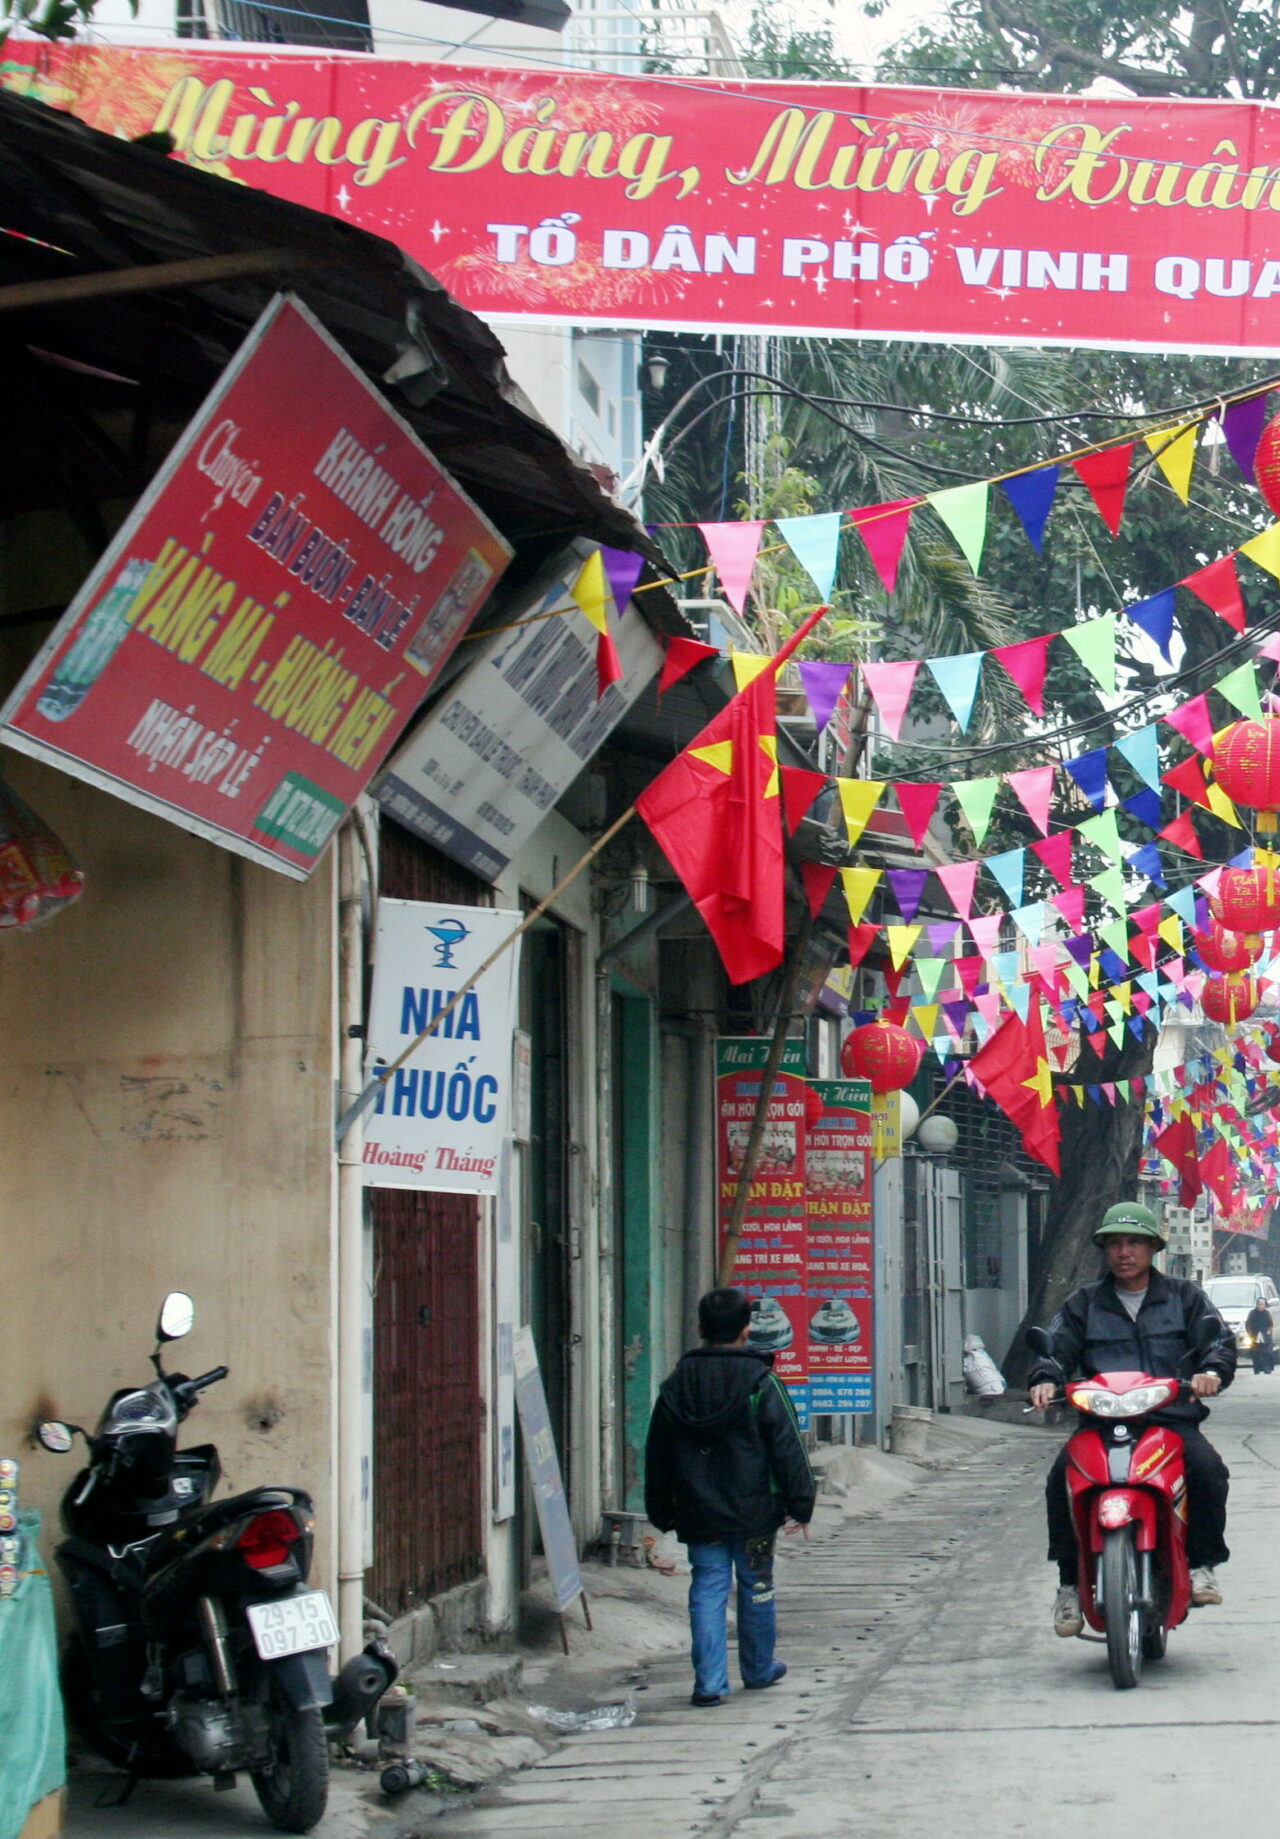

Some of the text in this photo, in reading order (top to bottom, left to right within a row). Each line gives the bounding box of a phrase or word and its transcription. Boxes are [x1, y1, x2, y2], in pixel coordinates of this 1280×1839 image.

[151, 74, 408, 189] Mừng
[406, 90, 702, 200] Đảng,
[725, 107, 1003, 216] Mừng
[486, 212, 577, 266] TỔ
[603, 222, 756, 275] DÂN
[782, 230, 936, 283] PHỐ
[954, 247, 1128, 292] VINH
[313, 427, 399, 530] KHÁNH
[247, 491, 311, 566] BÁN
[287, 526, 357, 604] BUÔN
[342, 573, 397, 637] BÁN
[123, 531, 236, 665] VÀNG
[252, 633, 360, 746] HƯƠNG
[325, 672, 406, 772] NẾN
[126, 698, 205, 773] NHẬN
[400, 985, 480, 1042] NHÀ
[372, 1055, 498, 1124] THUỐC
[362, 1141, 428, 1174] Hoàng
[770, 1178, 803, 1201] ĐẶT
[842, 1197, 872, 1217] ĐẶT
[770, 1254, 781, 1264] XE
[840, 1262, 850, 1271] XE
